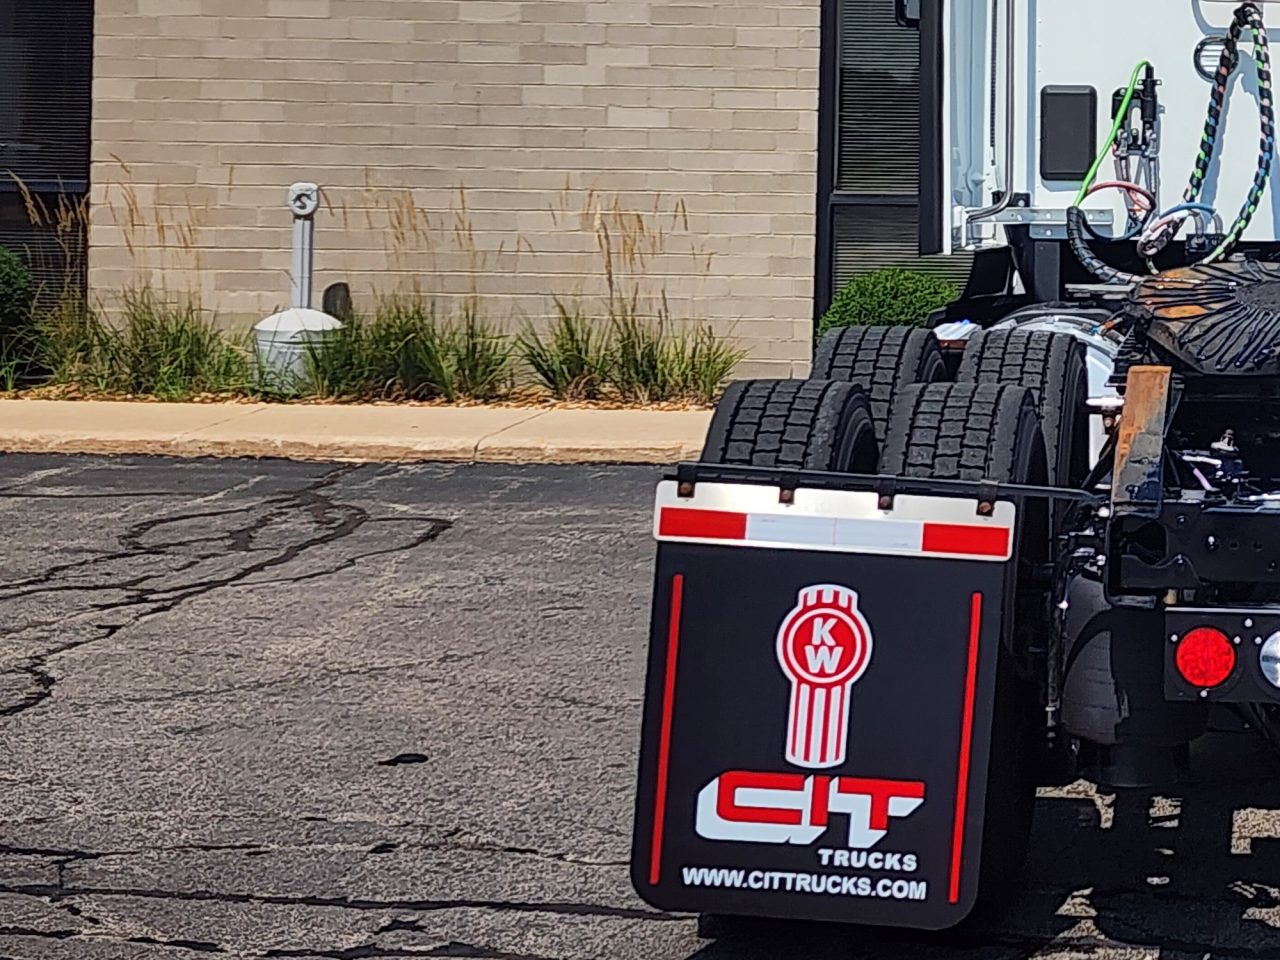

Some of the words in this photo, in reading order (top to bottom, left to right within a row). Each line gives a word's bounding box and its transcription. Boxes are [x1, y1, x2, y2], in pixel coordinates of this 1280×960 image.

[695, 770, 926, 848] CIT
[817, 848, 918, 871] TRUCKS
[682, 867, 928, 900] WWW.CITTRUCKS.COM
